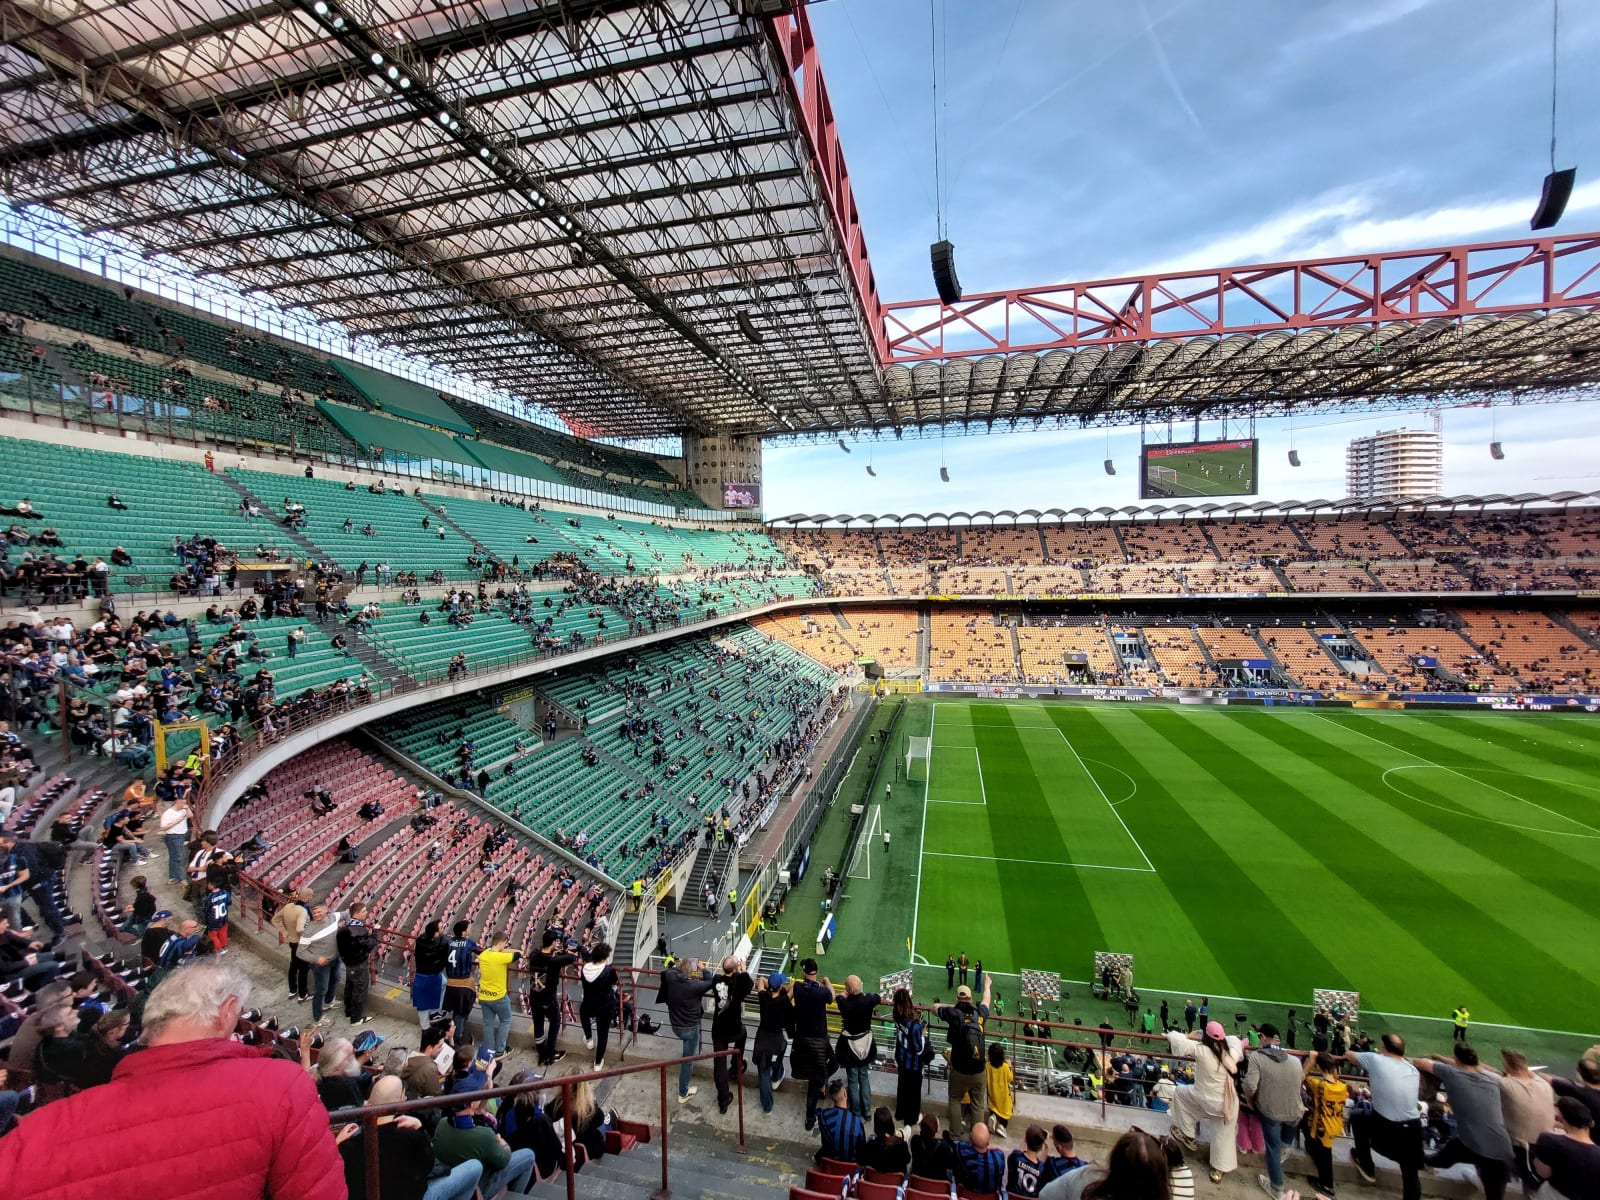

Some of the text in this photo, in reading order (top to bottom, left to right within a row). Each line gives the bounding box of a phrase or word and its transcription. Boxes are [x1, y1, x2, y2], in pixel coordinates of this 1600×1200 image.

[213, 902, 228, 919] 10
[448, 949, 457, 968] 4
[1017, 1168, 1038, 1193] 10
